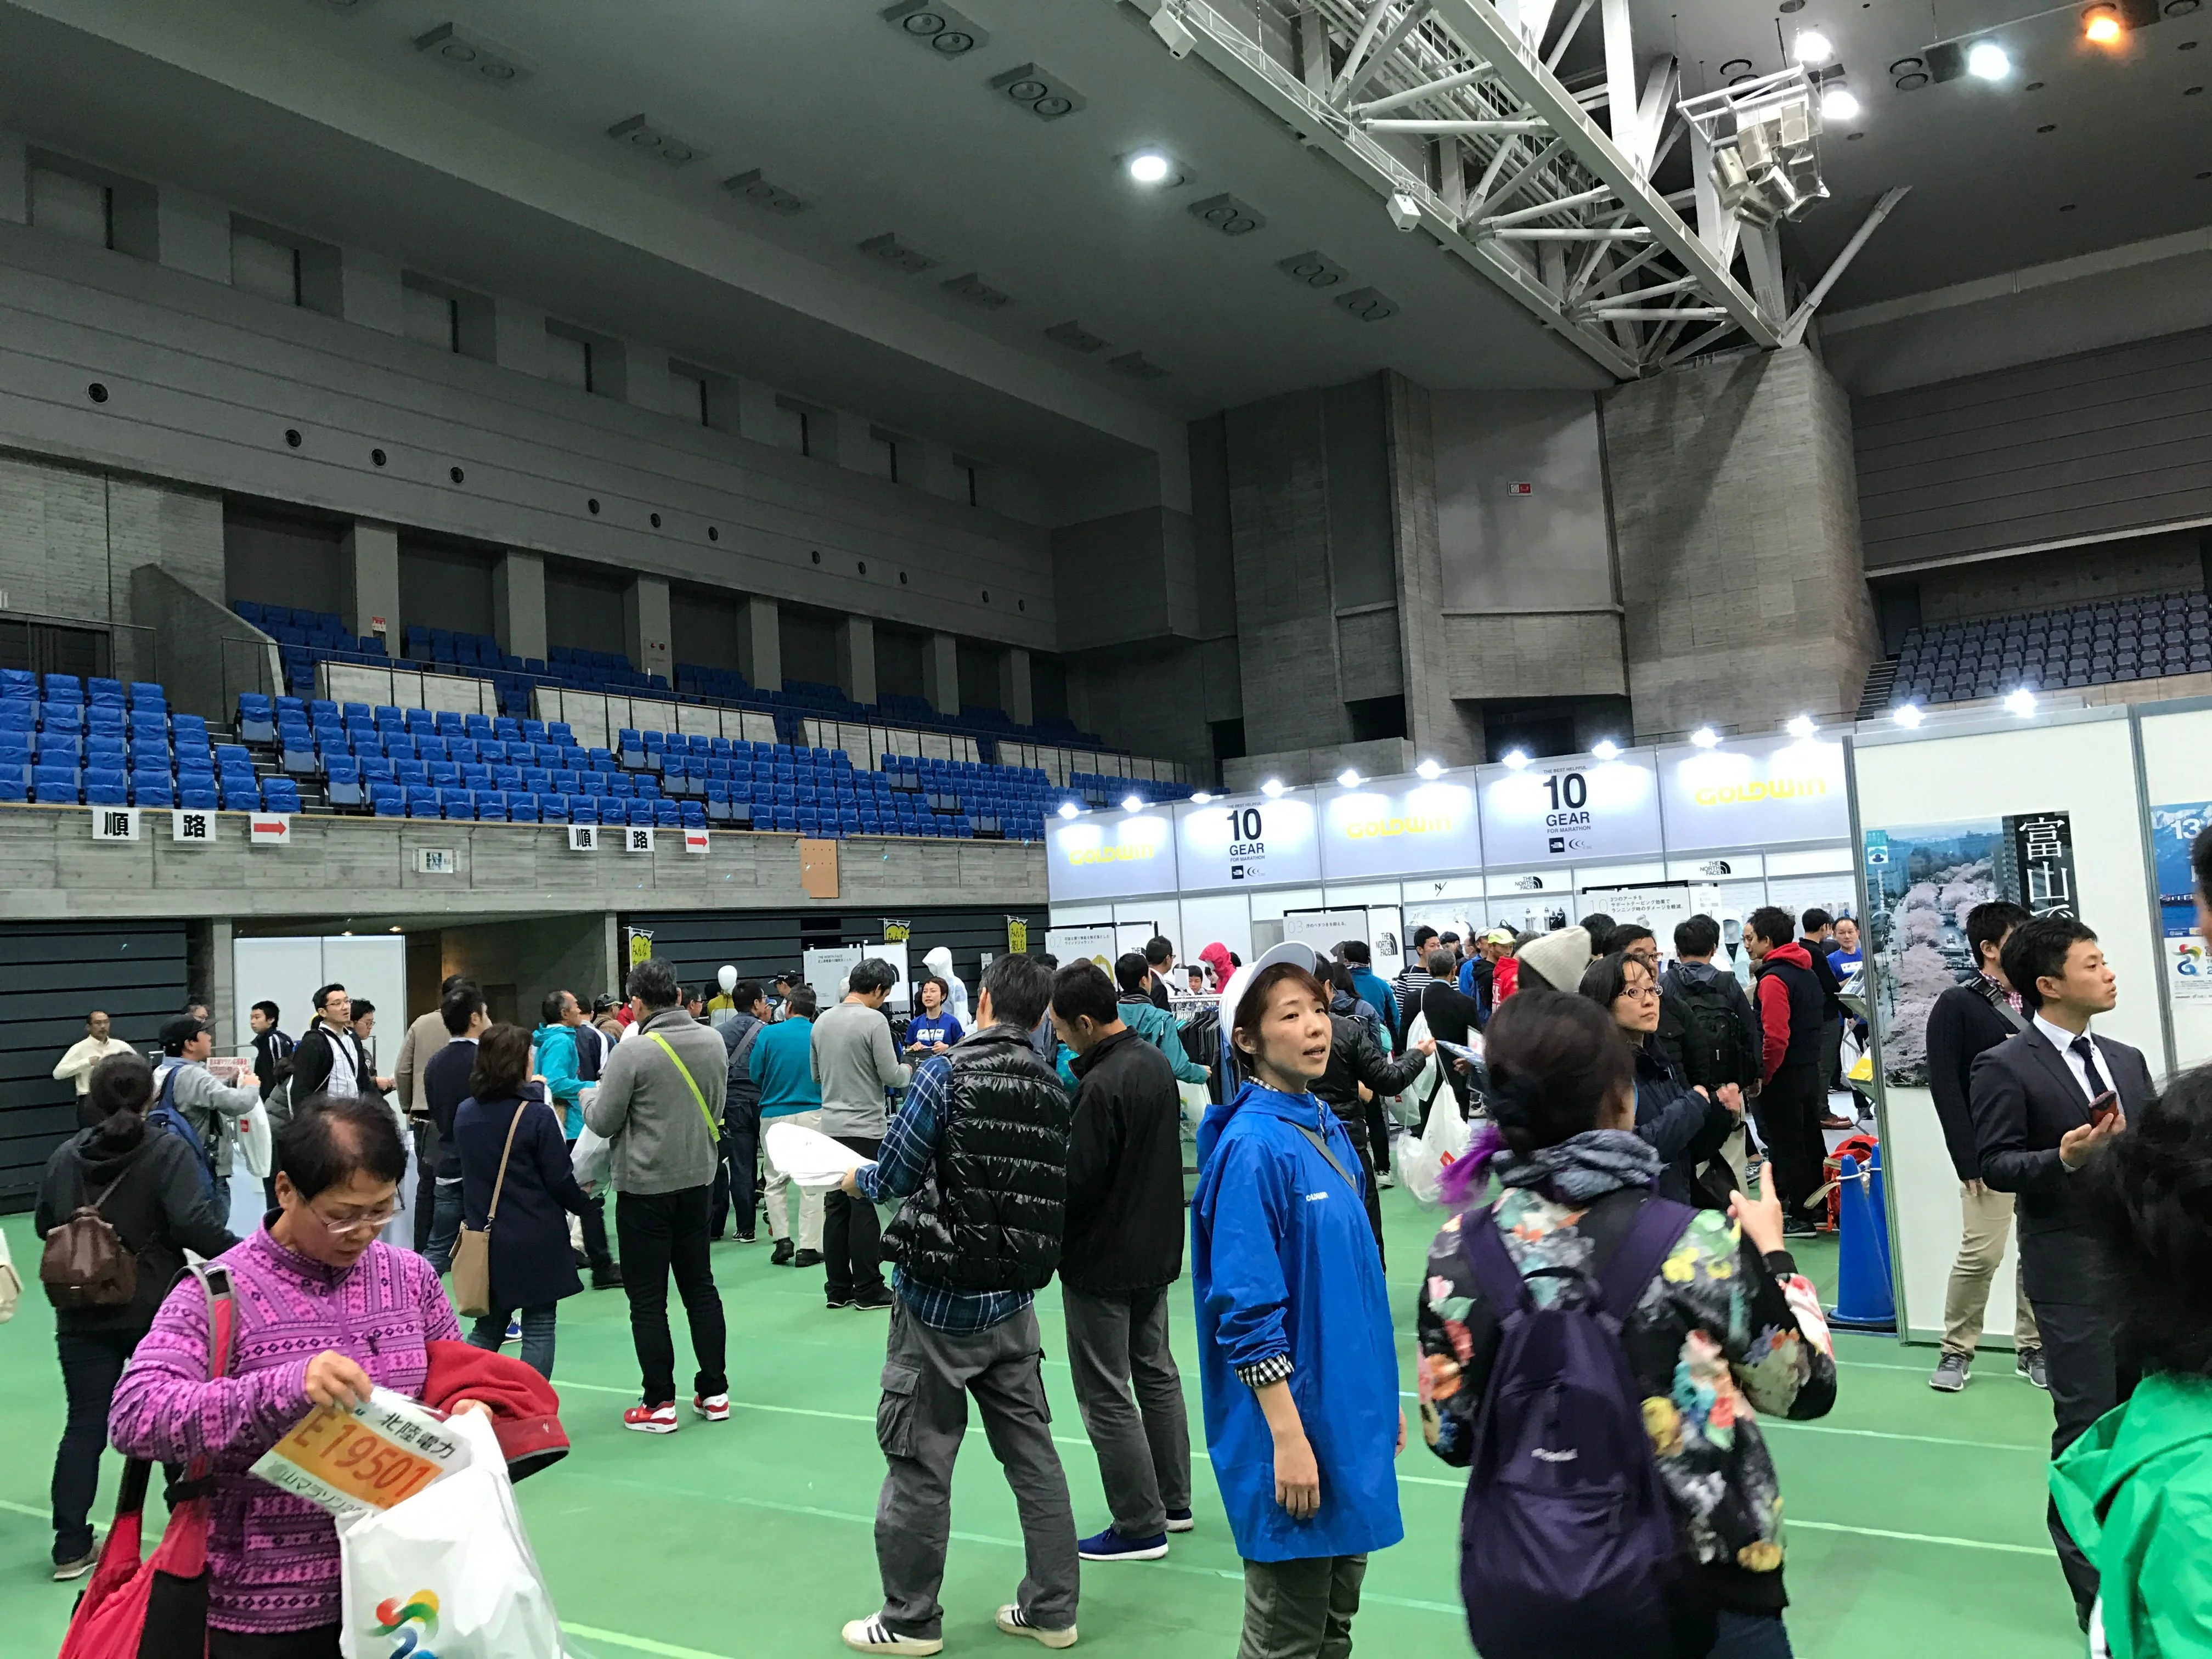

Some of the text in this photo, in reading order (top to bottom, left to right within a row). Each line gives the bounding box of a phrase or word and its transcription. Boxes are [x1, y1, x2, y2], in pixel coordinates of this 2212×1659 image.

[1543, 773, 1587, 810] 10
[104, 811, 206, 838] 順 路
[1227, 808, 1262, 841] 10
[1546, 811, 1590, 827] GEAR
[2171, 818, 2212, 839] 13
[575, 828, 648, 849] 順 路
[1229, 843, 1265, 856] GEAR
[1288, 921, 1304, 933] 03
[1049, 936, 1062, 948] 02
[1375, 940, 1390, 949] NORTH
[1380, 948, 1391, 956] FACE
[376, 1412, 456, 1459] 北陸電力
